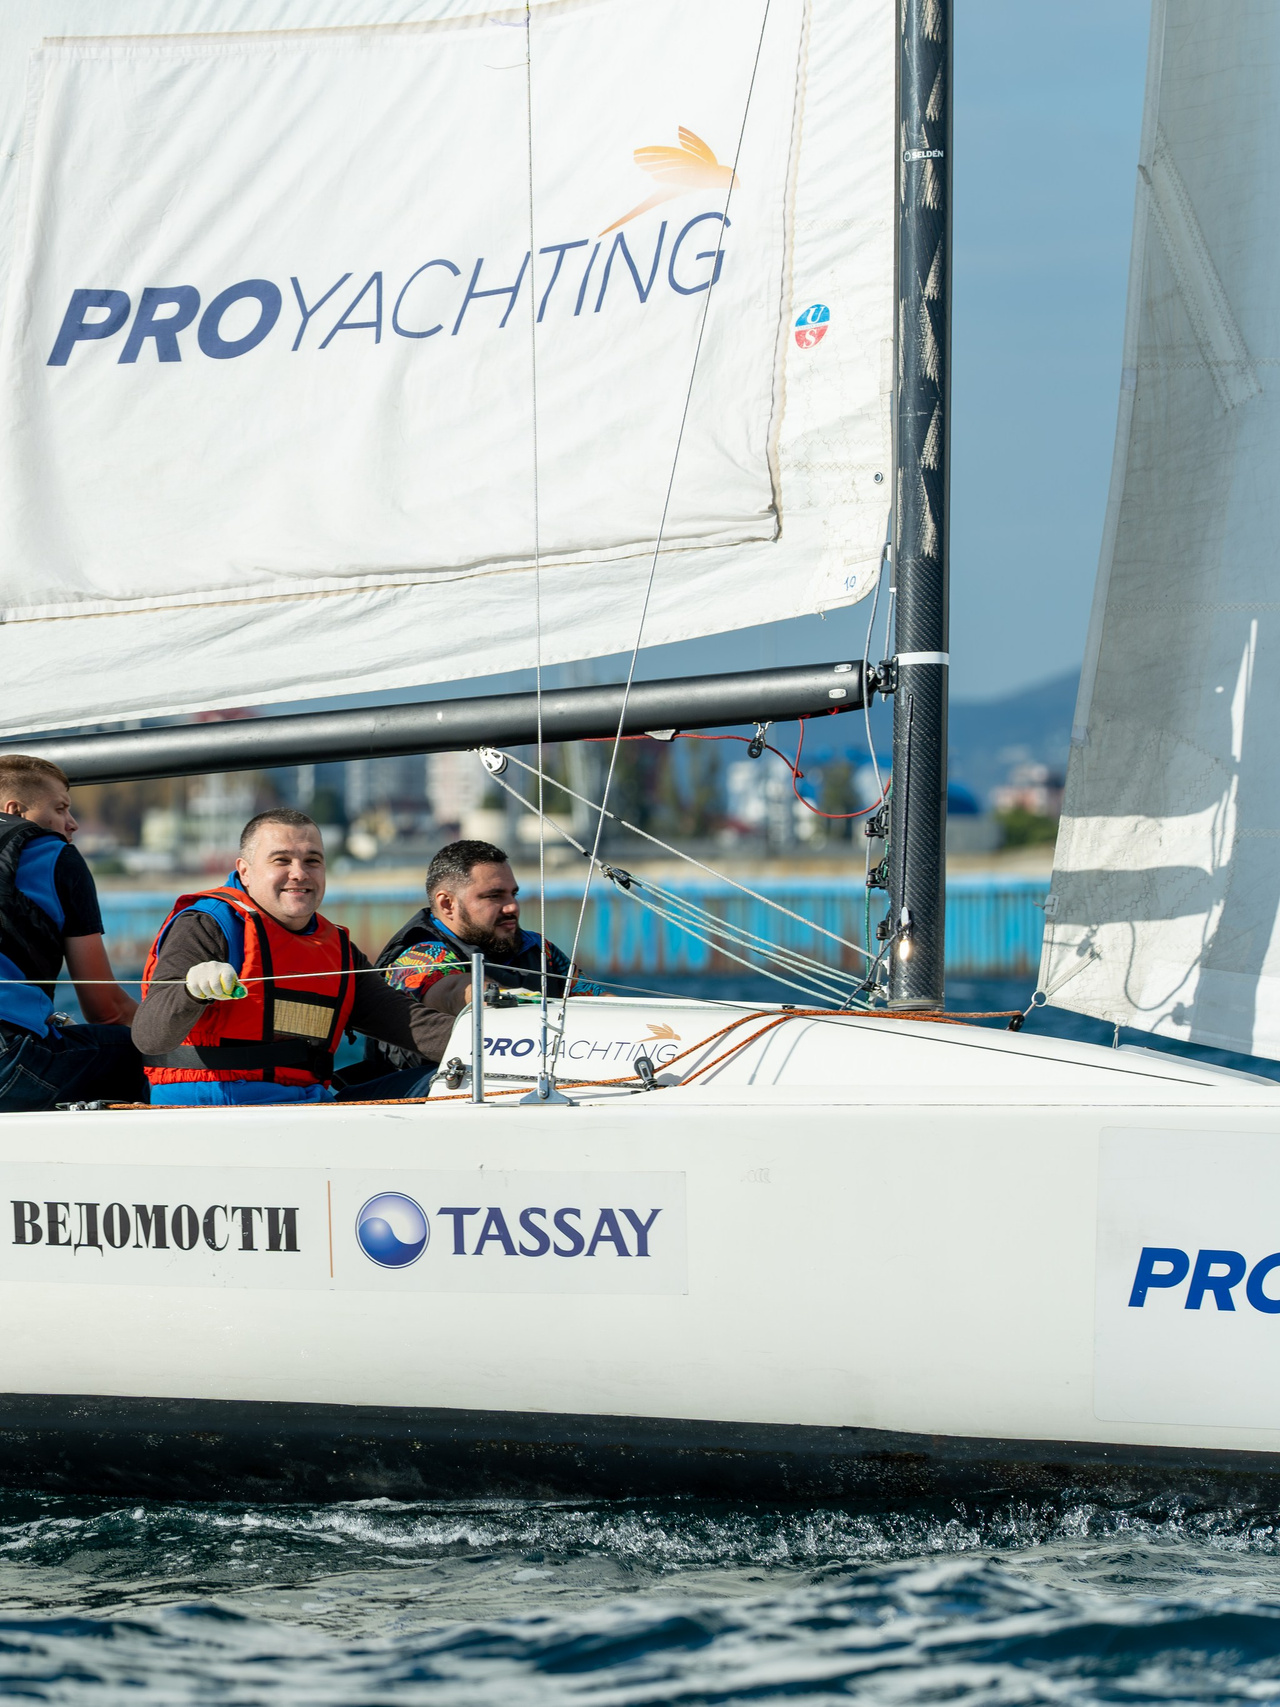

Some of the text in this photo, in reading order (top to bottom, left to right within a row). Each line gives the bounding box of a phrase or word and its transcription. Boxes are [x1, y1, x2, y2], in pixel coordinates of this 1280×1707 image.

[912, 149, 944, 159] SELDÉN
[47, 211, 732, 366] PROYACHTING
[10, 1200, 302, 1257] ВЕДОМОСТИ
[437, 1206, 664, 1258] TASSAY
